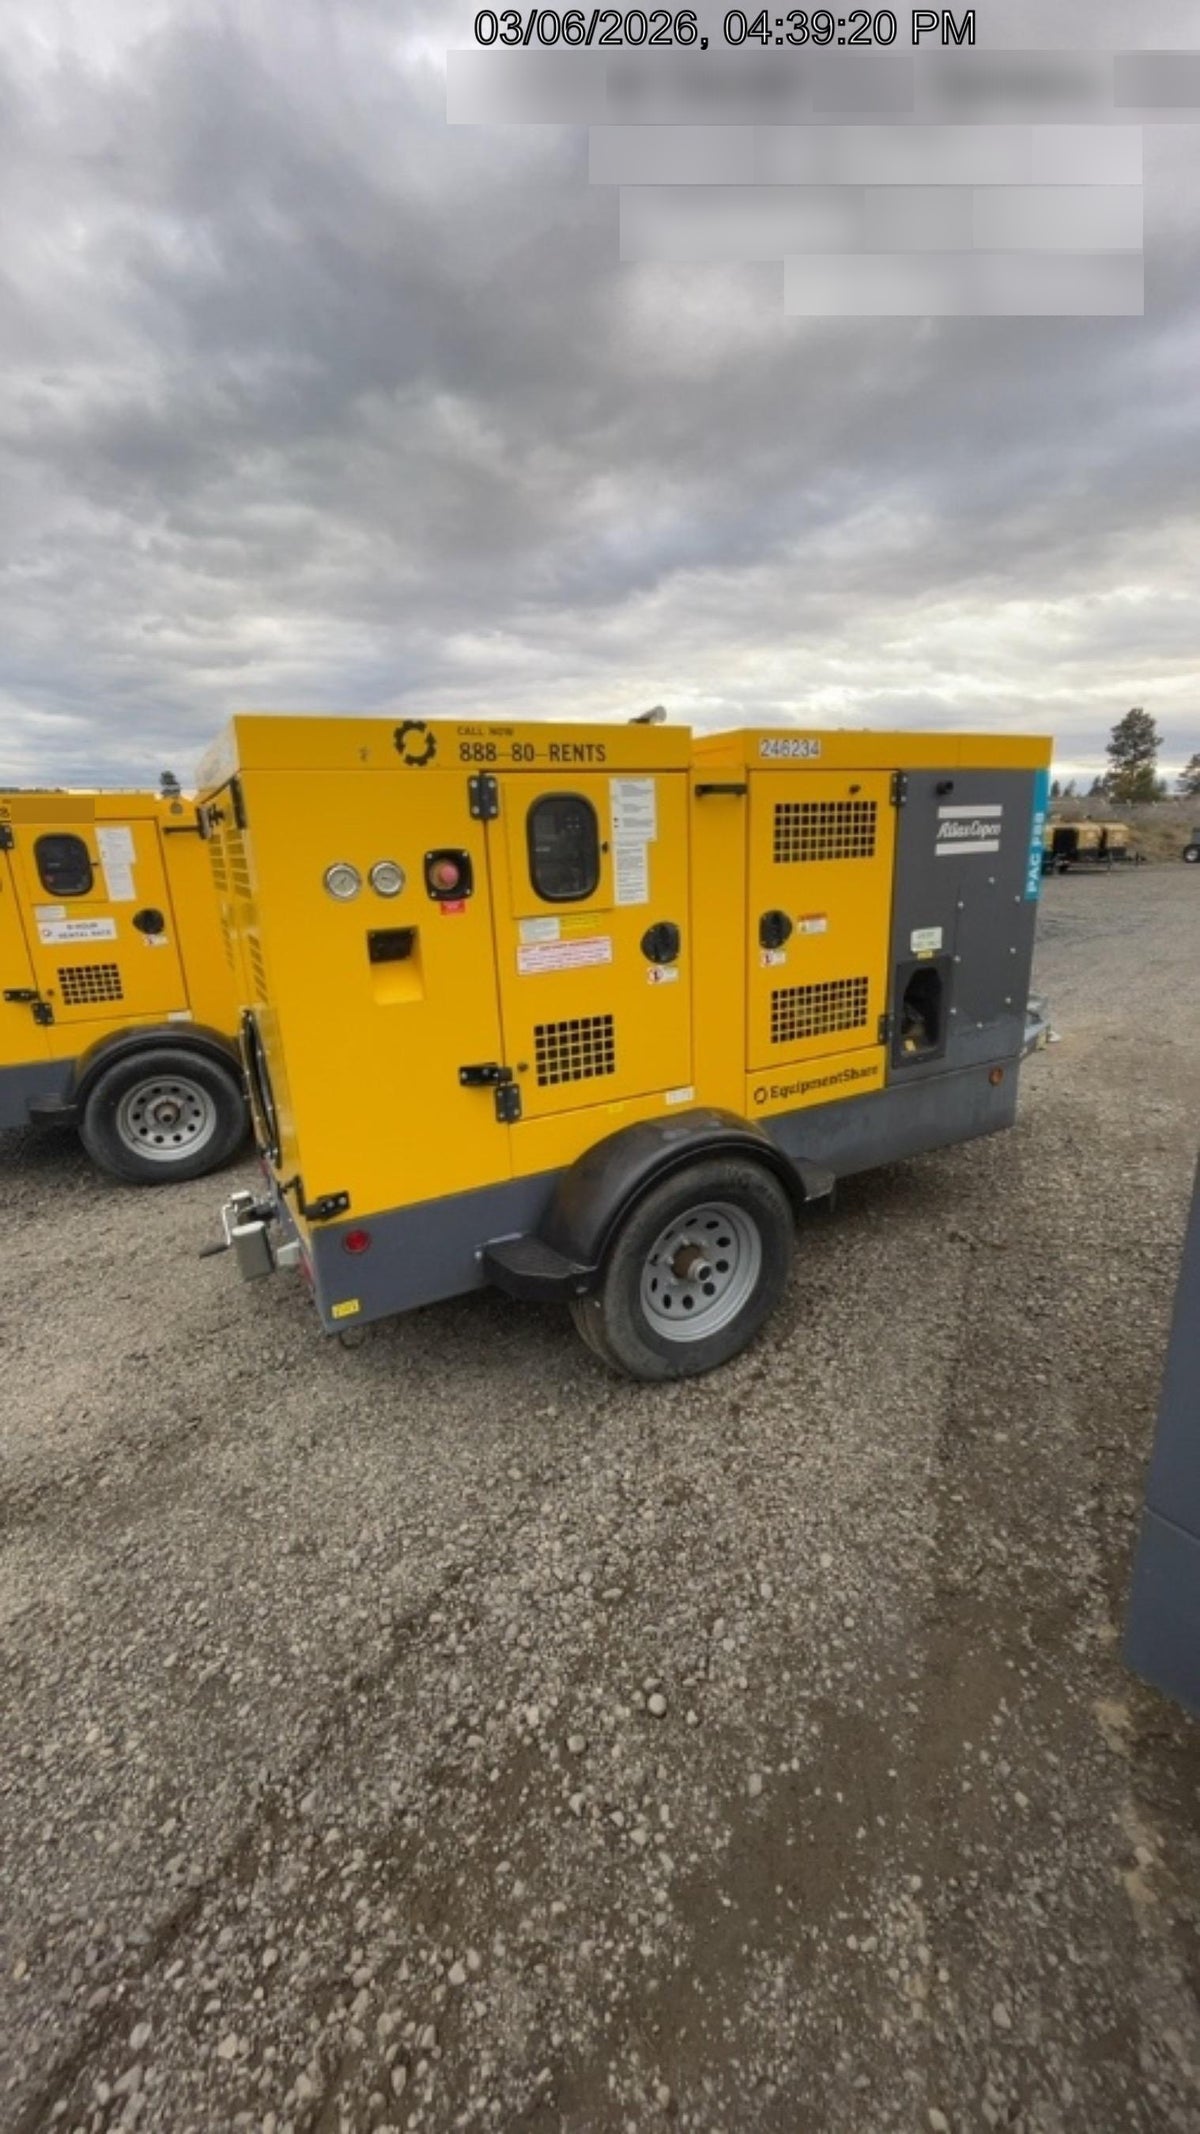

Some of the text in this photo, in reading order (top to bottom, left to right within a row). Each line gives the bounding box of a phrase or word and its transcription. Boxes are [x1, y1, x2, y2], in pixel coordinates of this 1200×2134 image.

[458, 727, 513, 736] CALL NOW
[937, 820, 1001, 840] Atlas Copco
[1026, 852, 1041, 893] PAC
[769, 1066, 878, 1099] EquipmentShare
